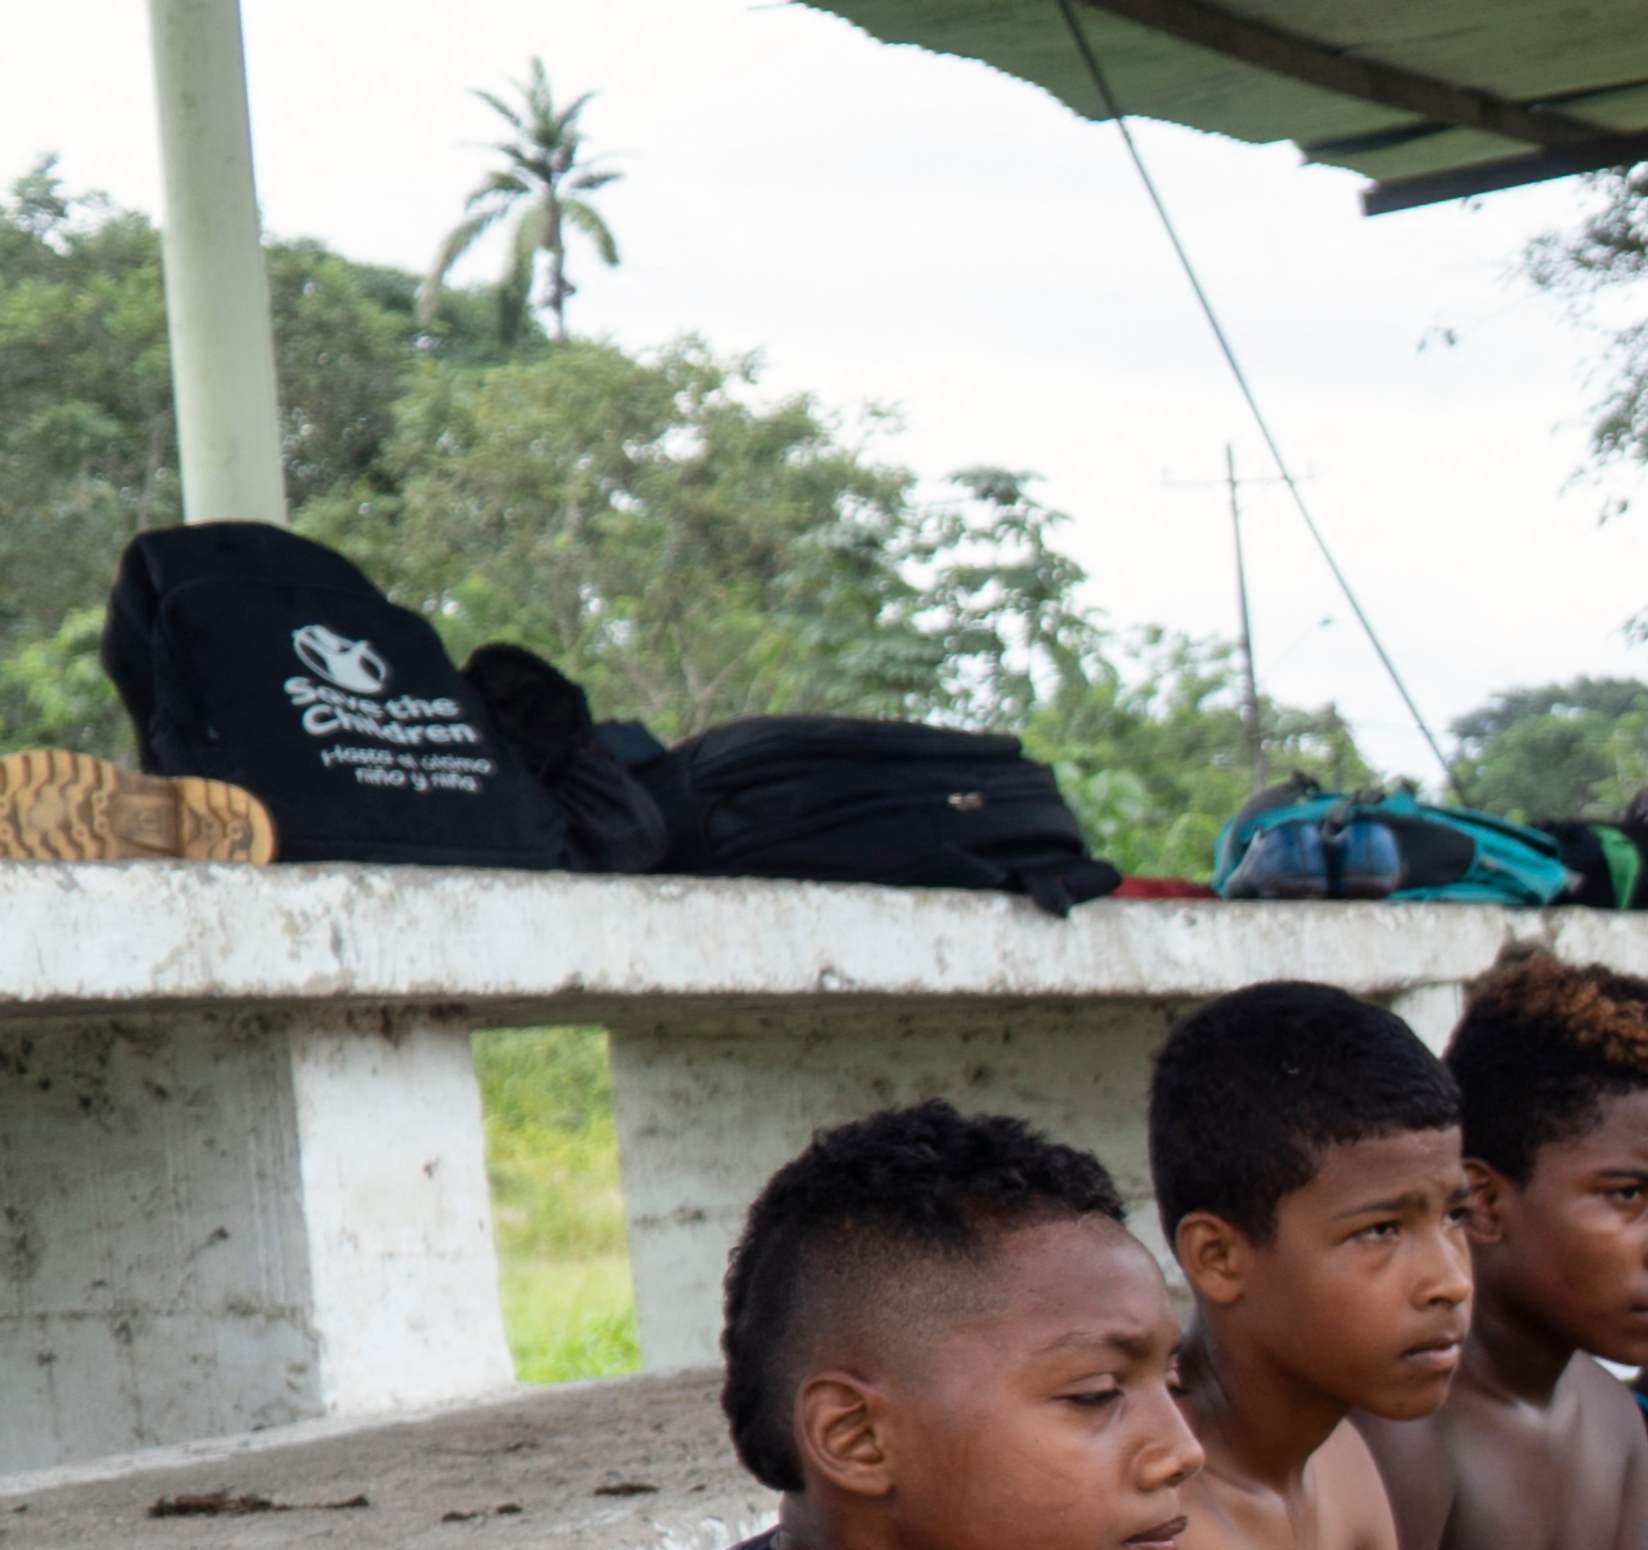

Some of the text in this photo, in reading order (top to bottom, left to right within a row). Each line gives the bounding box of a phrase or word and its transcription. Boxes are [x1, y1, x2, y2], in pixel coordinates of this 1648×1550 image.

[284, 676, 460, 719] Save the
[303, 704, 477, 743] Children
[411, 770, 428, 791] y
